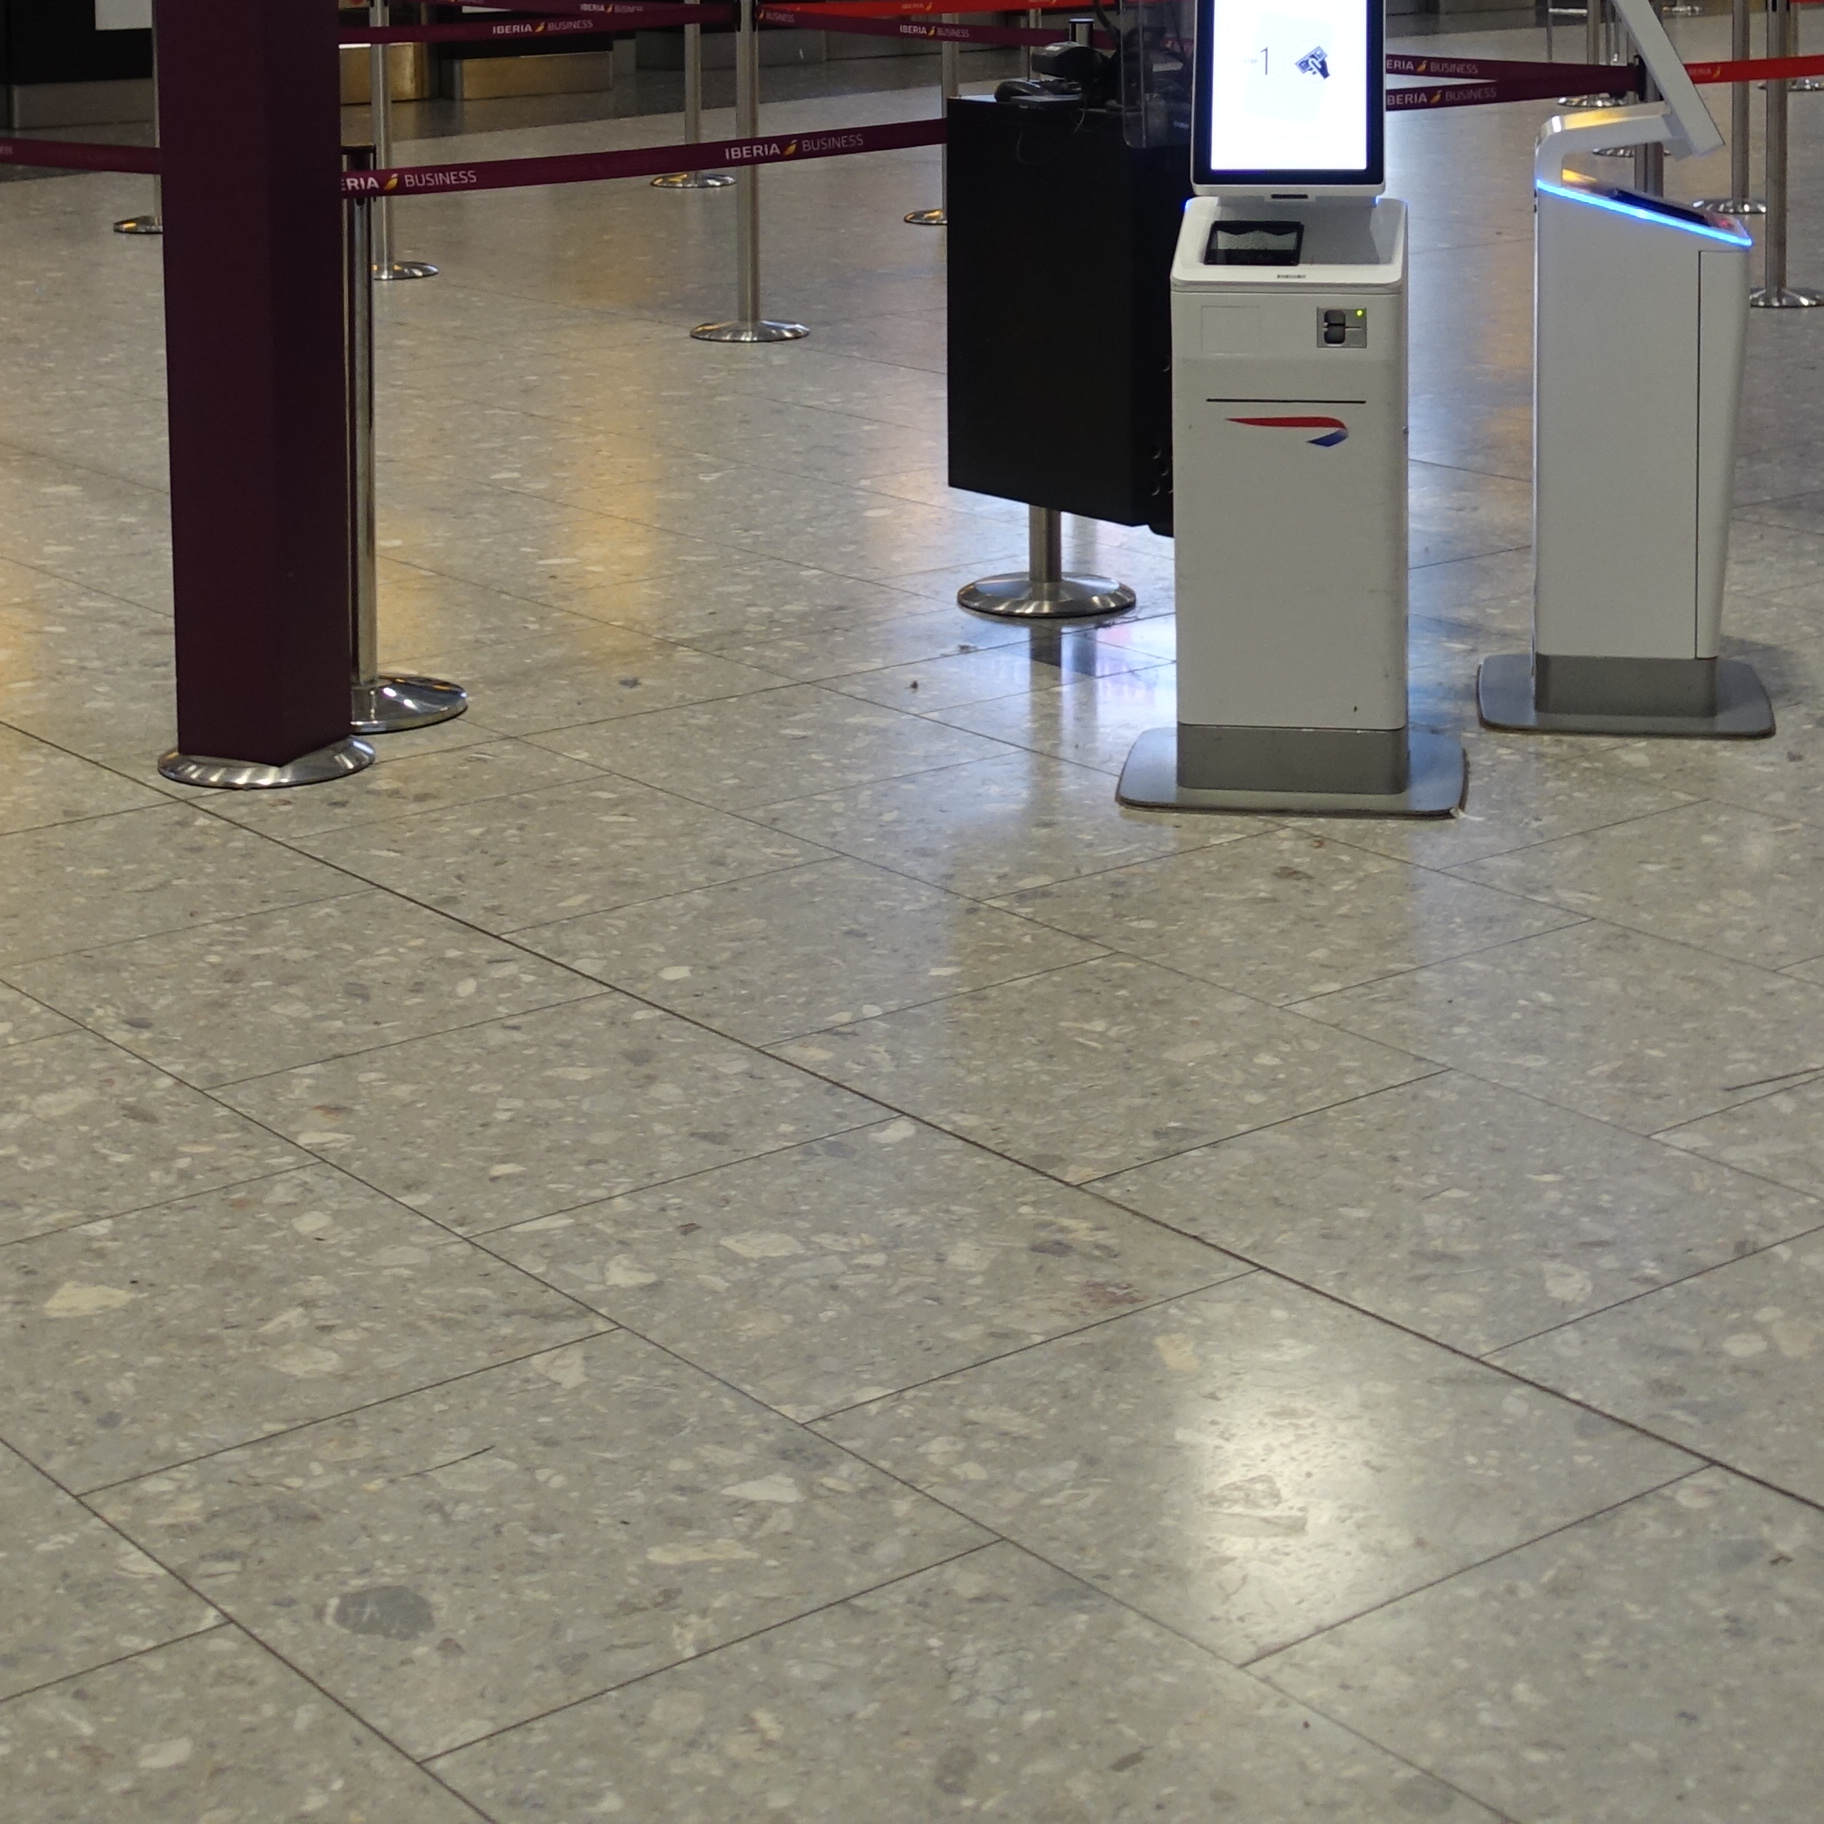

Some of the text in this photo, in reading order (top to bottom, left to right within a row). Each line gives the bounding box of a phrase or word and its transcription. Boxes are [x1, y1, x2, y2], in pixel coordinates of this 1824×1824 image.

[580, 3, 606, 13] IBERIA
[492, 19, 594, 35] IBERIA BUSINESS
[899, 24, 970, 38] IBERIA BUSINESS
[1260, 46, 1269, 76] 1
[1386, 59, 1479, 75] ERIA BUSINESS
[1387, 87, 1497, 106] BERIA BUSINESS
[725, 133, 865, 160] IBERIA BUSINESS
[404, 170, 478, 188] BUSINESS
